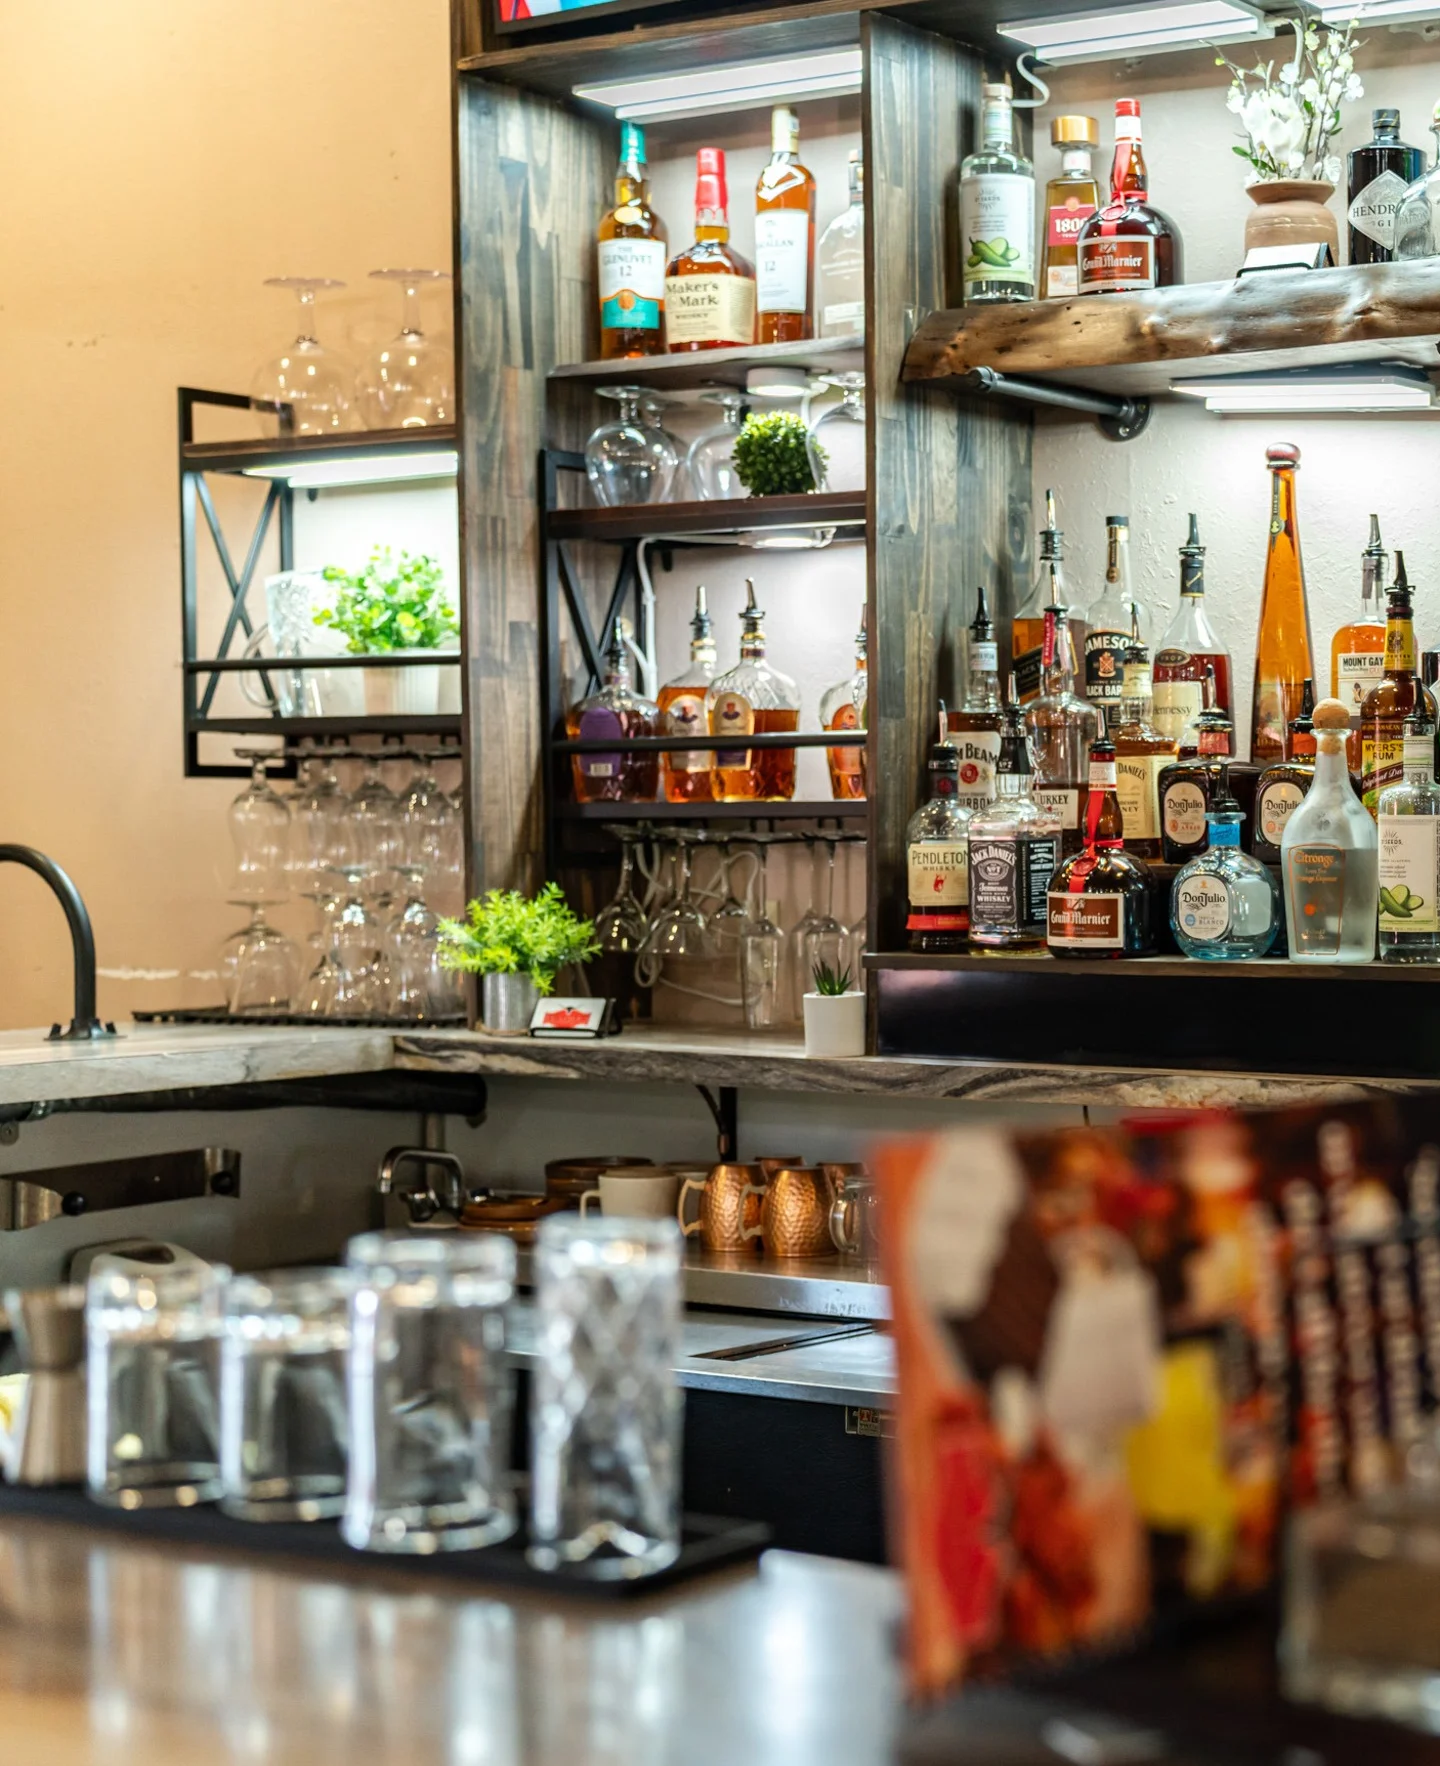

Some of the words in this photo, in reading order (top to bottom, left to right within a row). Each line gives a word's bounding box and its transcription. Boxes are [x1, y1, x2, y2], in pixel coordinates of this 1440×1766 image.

[618, 265, 633, 278] 12
[666, 281, 719, 294] Maker's
[679, 294, 719, 307] Mark
[1343, 656, 1367, 667] MOUNT
[1368, 656, 1384, 666] GAY
[965, 743, 998, 763] BEAM
[1372, 752, 1394, 761] RUM
[1168, 799, 1184, 809] Don
[1184, 799, 1203, 813] Julio
[1265, 799, 1282, 810] Don
[970, 848, 988, 866] JACK
[987, 845, 1017, 866] DANIEL'S
[1182, 892, 1203, 903] Don
[1200, 892, 1226, 907] Julio
[1071, 911, 1112, 925] Marnier
